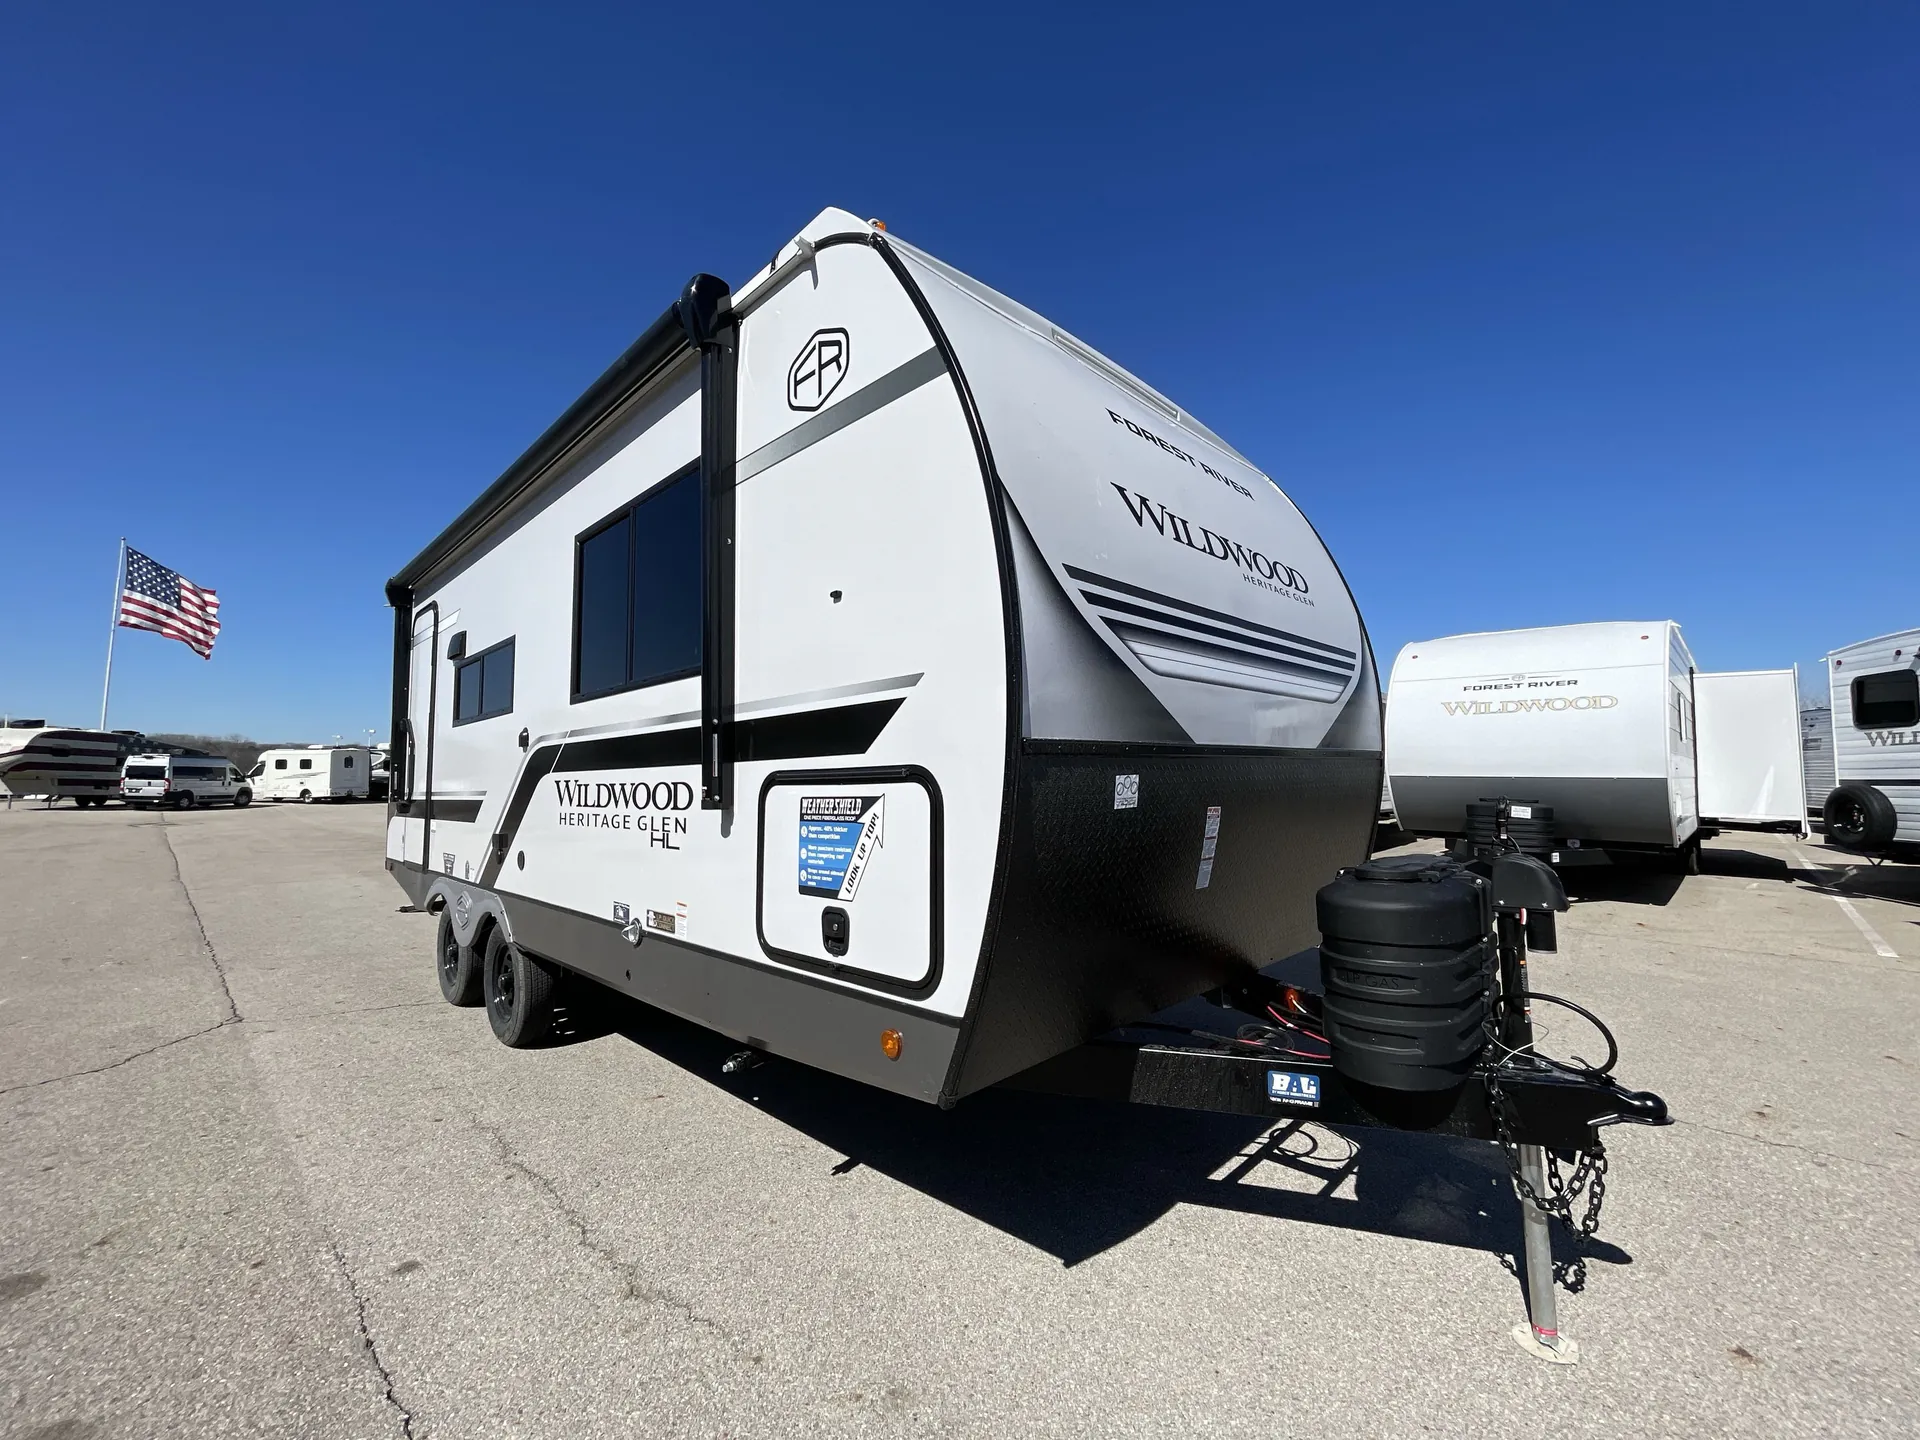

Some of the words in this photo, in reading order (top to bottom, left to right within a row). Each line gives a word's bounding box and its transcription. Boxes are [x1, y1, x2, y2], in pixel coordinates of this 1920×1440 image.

[1105, 408, 1196, 467] FOREST
[1198, 461, 1255, 501] RIVER
[1110, 481, 1309, 594] WILDWOOD
[1242, 573, 1292, 599] HERITAGE
[1292, 593, 1315, 608] GLEN
[1463, 683, 1524, 692] FOREST
[1528, 679, 1579, 687] RIVER
[1441, 695, 1618, 716] WILDWOOD
[554, 780, 694, 811] WILDWOOD
[559, 812, 631, 830] HERITAGE
[637, 815, 687, 834] GLEN
[650, 832, 680, 850] HL
[845, 863, 860, 894] LOOK
[857, 843, 866, 861] UP
[865, 813, 879, 840] TOP!
[1365, 975, 1400, 990] GAS
